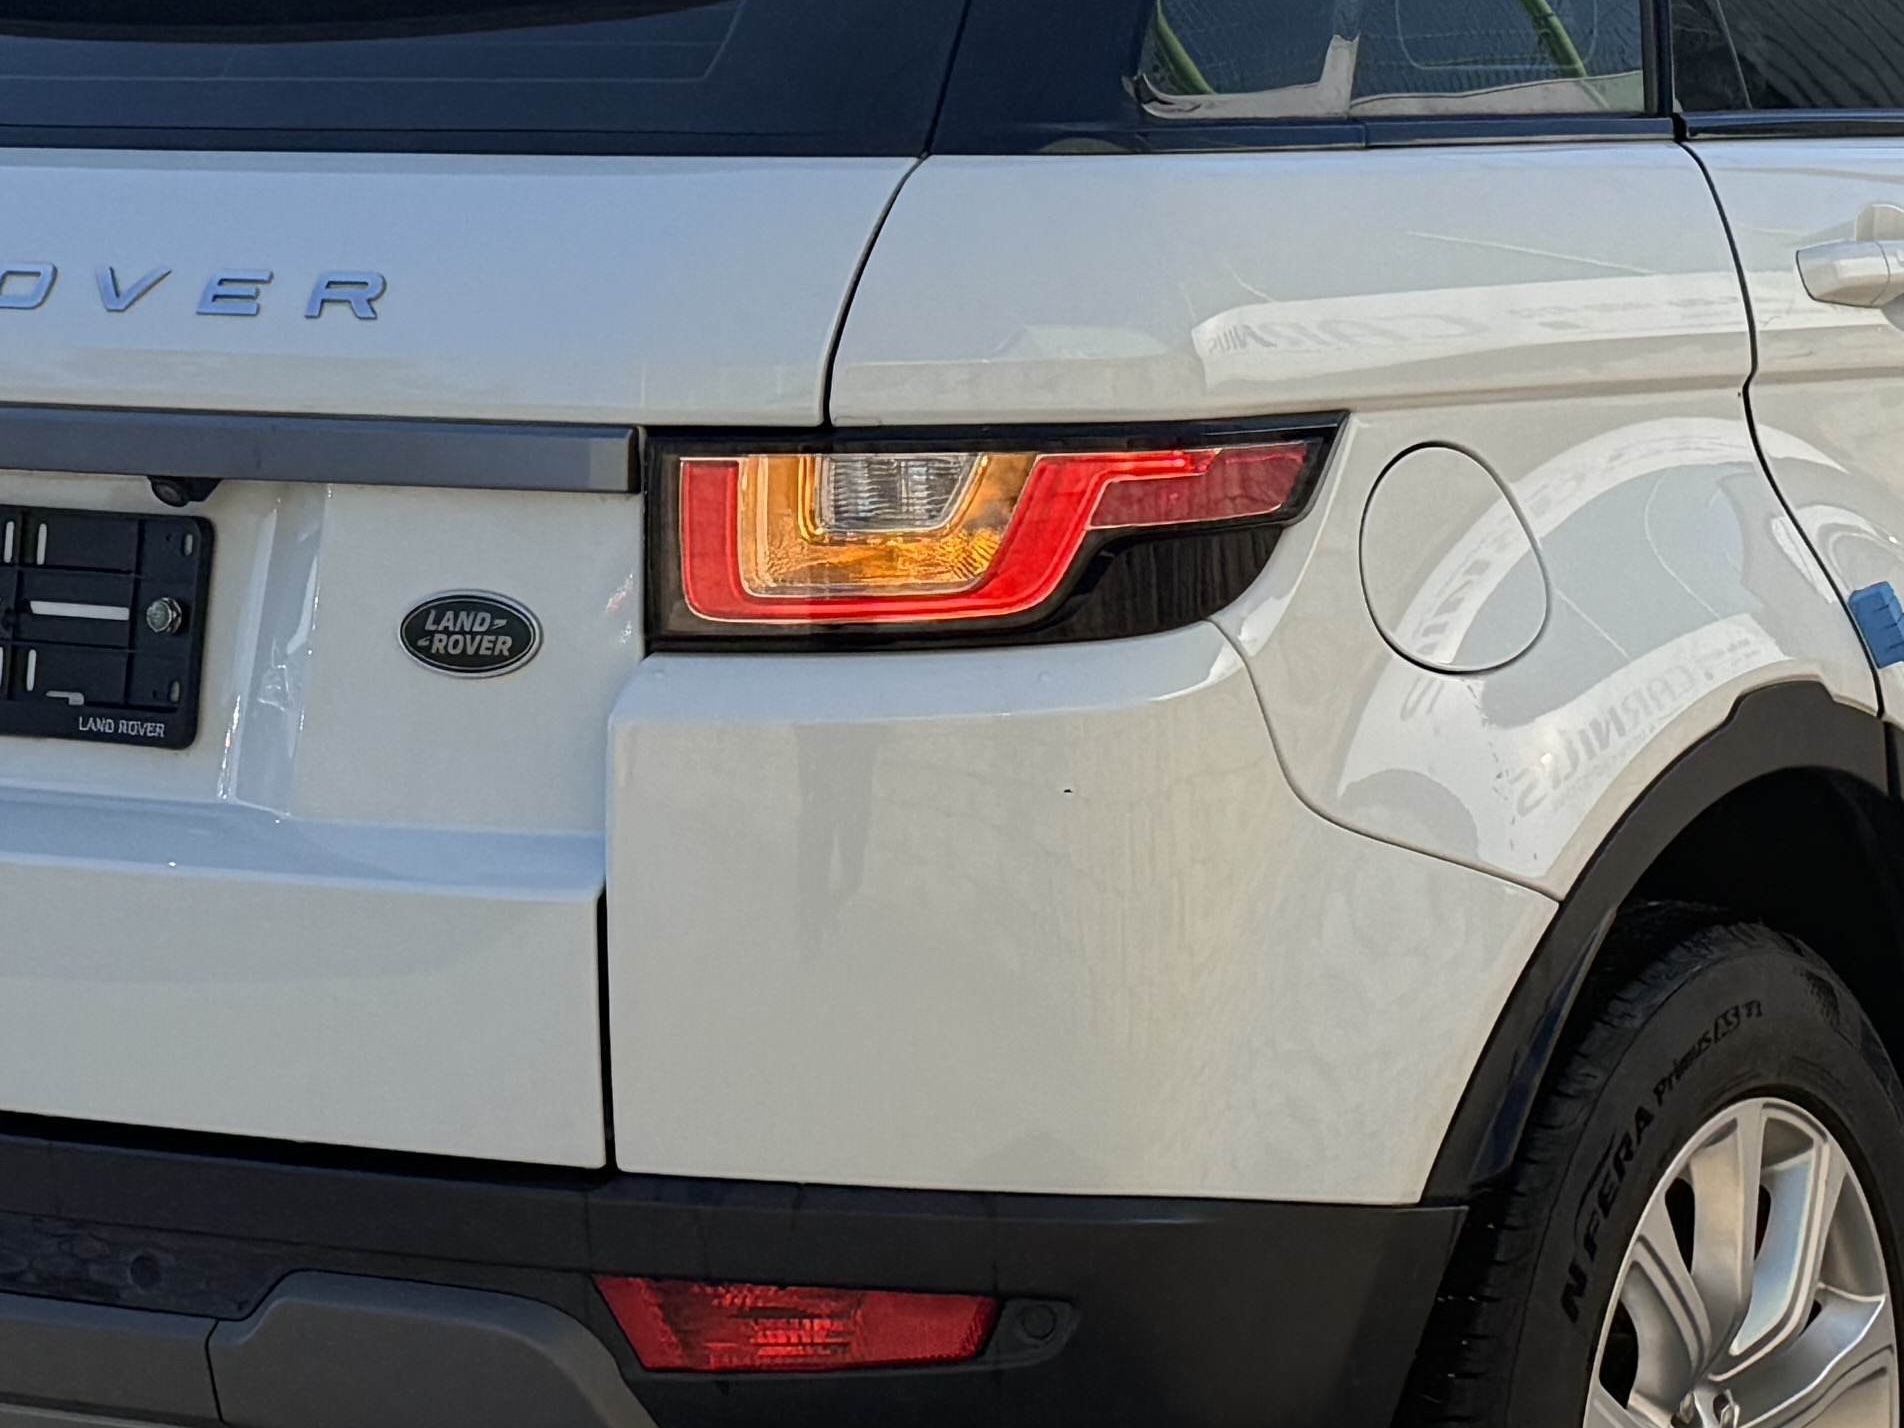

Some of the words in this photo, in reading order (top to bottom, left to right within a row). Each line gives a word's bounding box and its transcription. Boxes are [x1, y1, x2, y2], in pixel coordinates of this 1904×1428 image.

[424, 609, 490, 633] LAND
[427, 633, 513, 658] ROVER
[77, 715, 115, 736] LAND
[118, 718, 165, 739] ROVER
